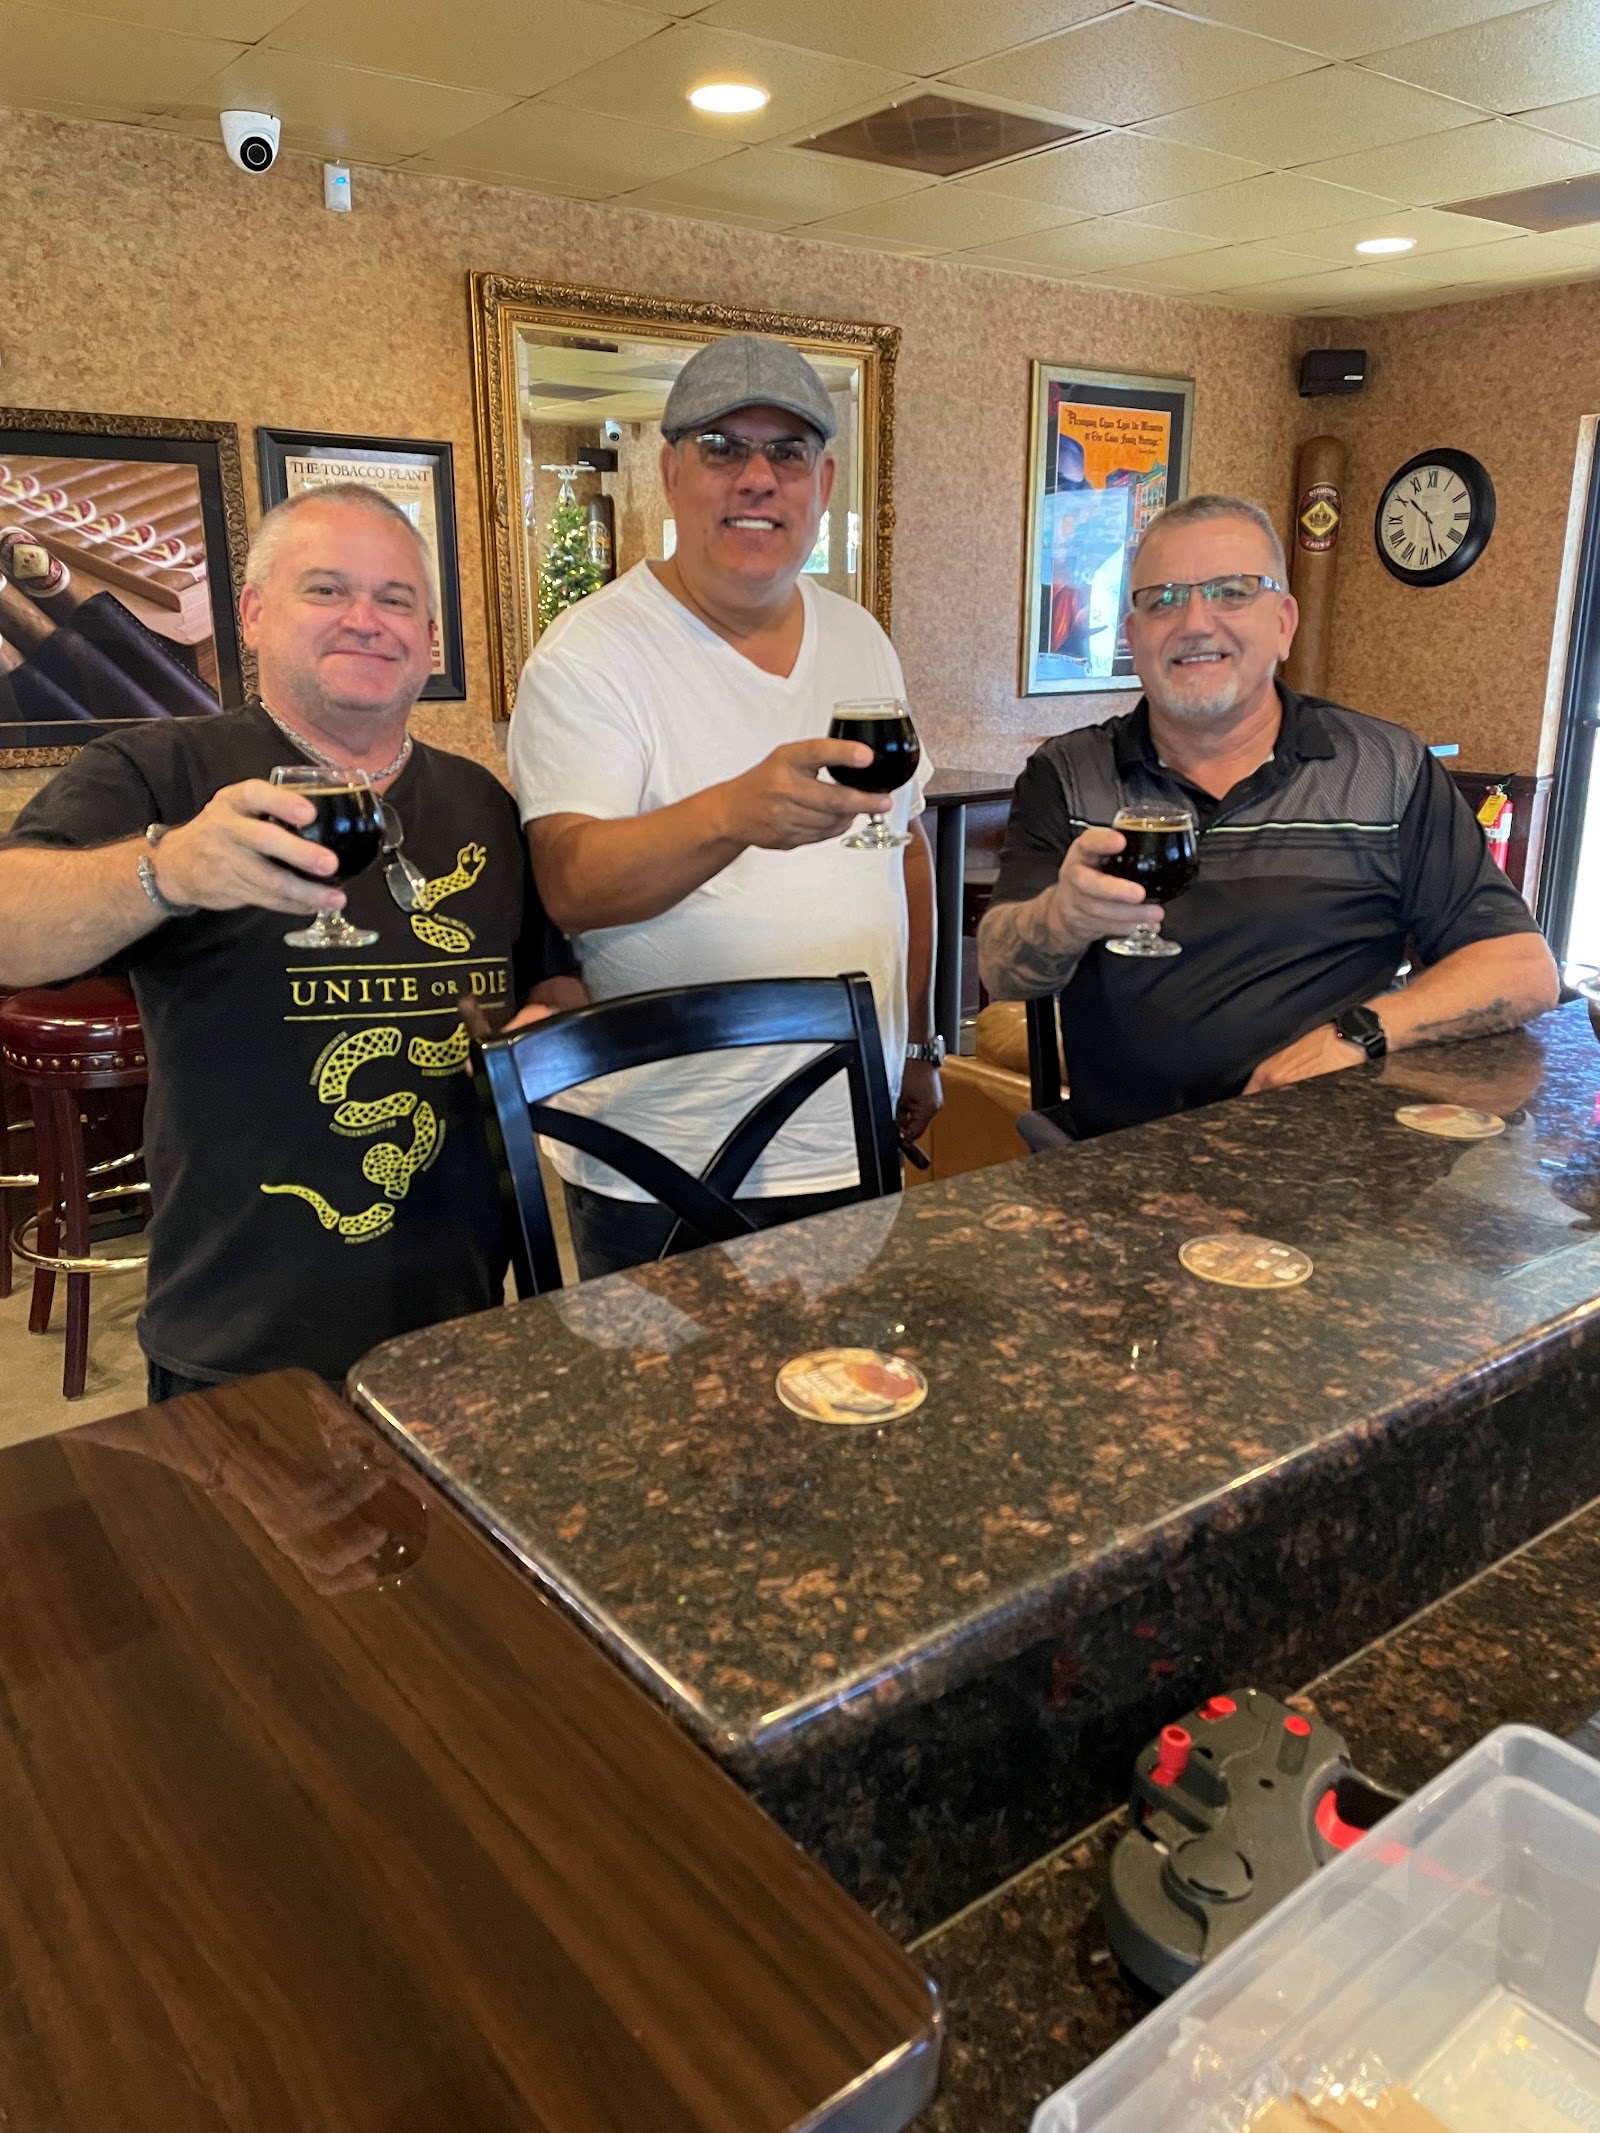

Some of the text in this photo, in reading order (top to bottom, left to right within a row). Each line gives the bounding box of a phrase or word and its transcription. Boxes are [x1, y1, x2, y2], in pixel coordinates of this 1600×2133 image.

[290, 461, 431, 482] THE TOBACCO PLANT
[1308, 487, 1338, 498] DIAMOND
[1305, 540, 1331, 550] CROWN
[290, 977, 419, 1007] UNITE
[468, 969, 508, 997] DIE
